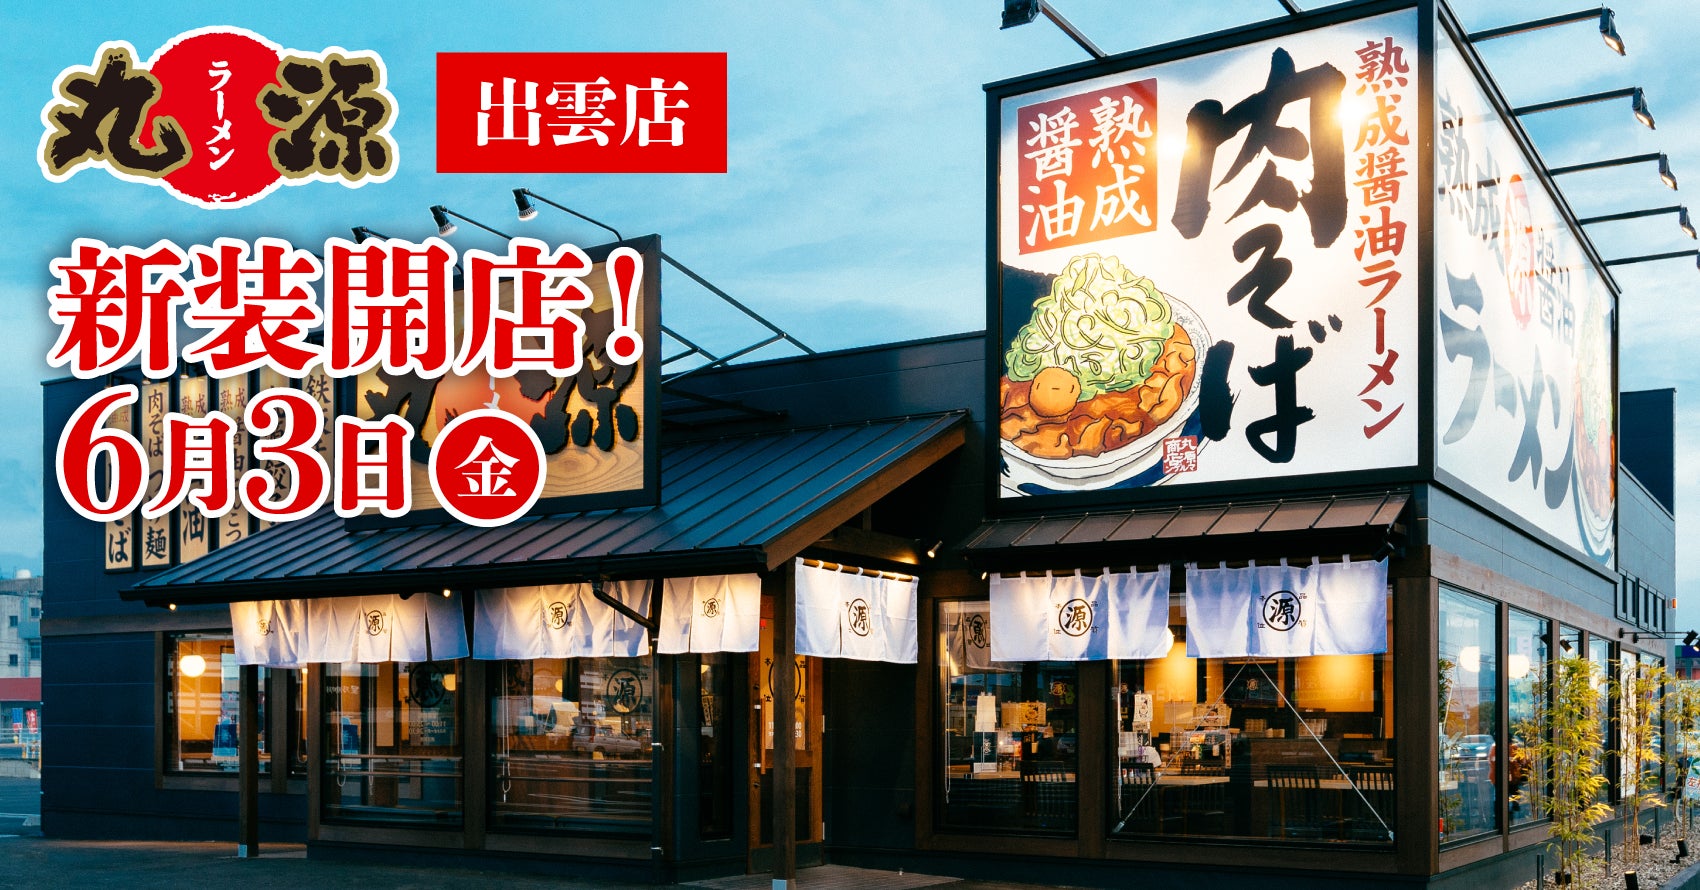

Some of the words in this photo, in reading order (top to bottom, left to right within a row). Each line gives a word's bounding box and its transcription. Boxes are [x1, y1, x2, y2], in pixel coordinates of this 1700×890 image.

[1021, 105, 1085, 247] 醤油
[1088, 95, 1153, 231] 熟成
[1354, 37, 1411, 439] 熟成醤油ラーメン
[1172, 47, 1347, 464] 肉そば
[367, 614, 381, 632] 源
[550, 606, 564, 625] 源
[853, 605, 869, 632] 源
[1064, 605, 1087, 632] 源
[1269, 597, 1296, 625] 源
